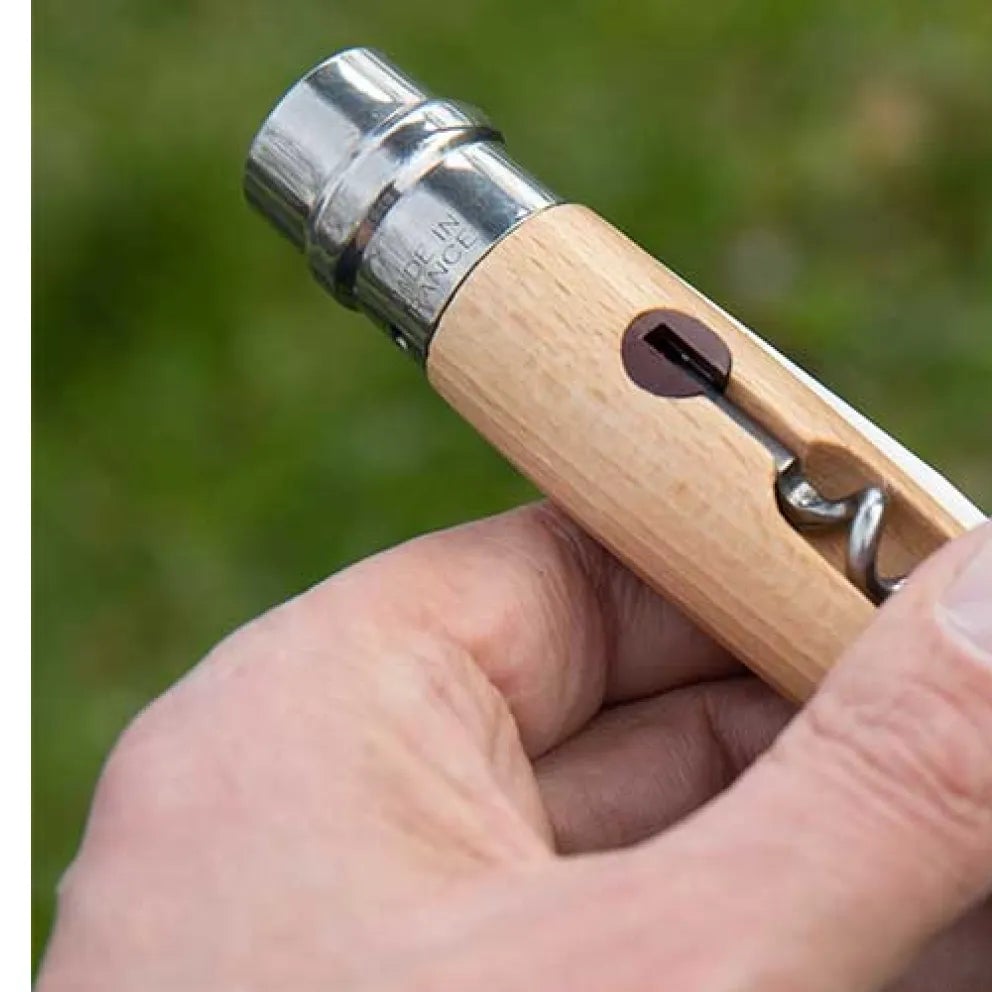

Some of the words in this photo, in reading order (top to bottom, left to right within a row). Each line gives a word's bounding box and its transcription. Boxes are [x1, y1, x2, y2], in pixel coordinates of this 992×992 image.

[392, 248, 433, 301] DE
[431, 213, 461, 241] IN
[407, 230, 478, 314] ANCE
